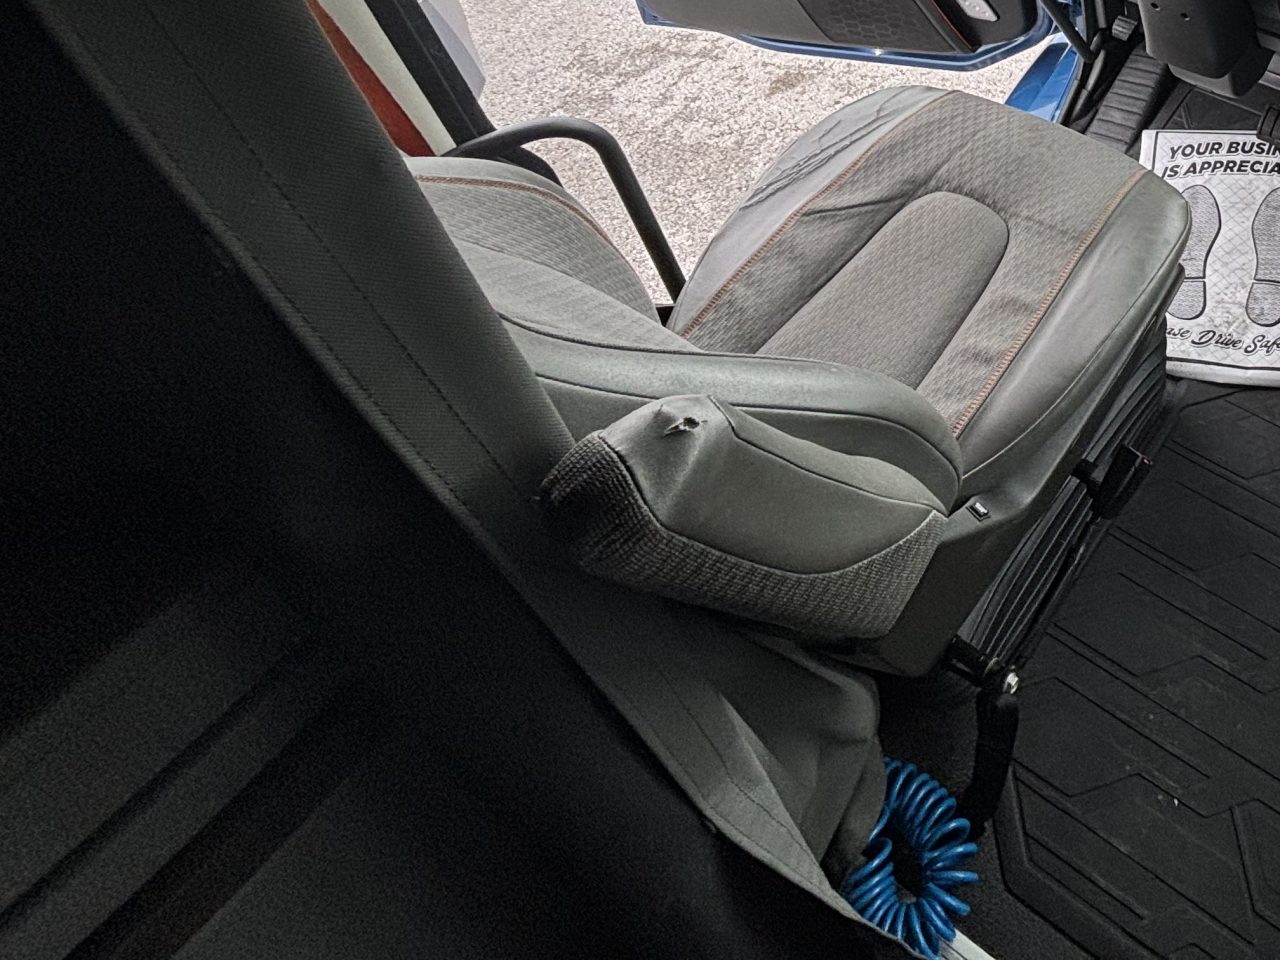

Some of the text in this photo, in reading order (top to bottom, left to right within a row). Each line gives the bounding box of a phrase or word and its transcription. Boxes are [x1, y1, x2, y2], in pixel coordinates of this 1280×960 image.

[1169, 142, 1223, 159] YOUR
[1162, 164, 1181, 179] IS
[1166, 327, 1191, 338] ase
[1191, 329, 1242, 348] Drive
